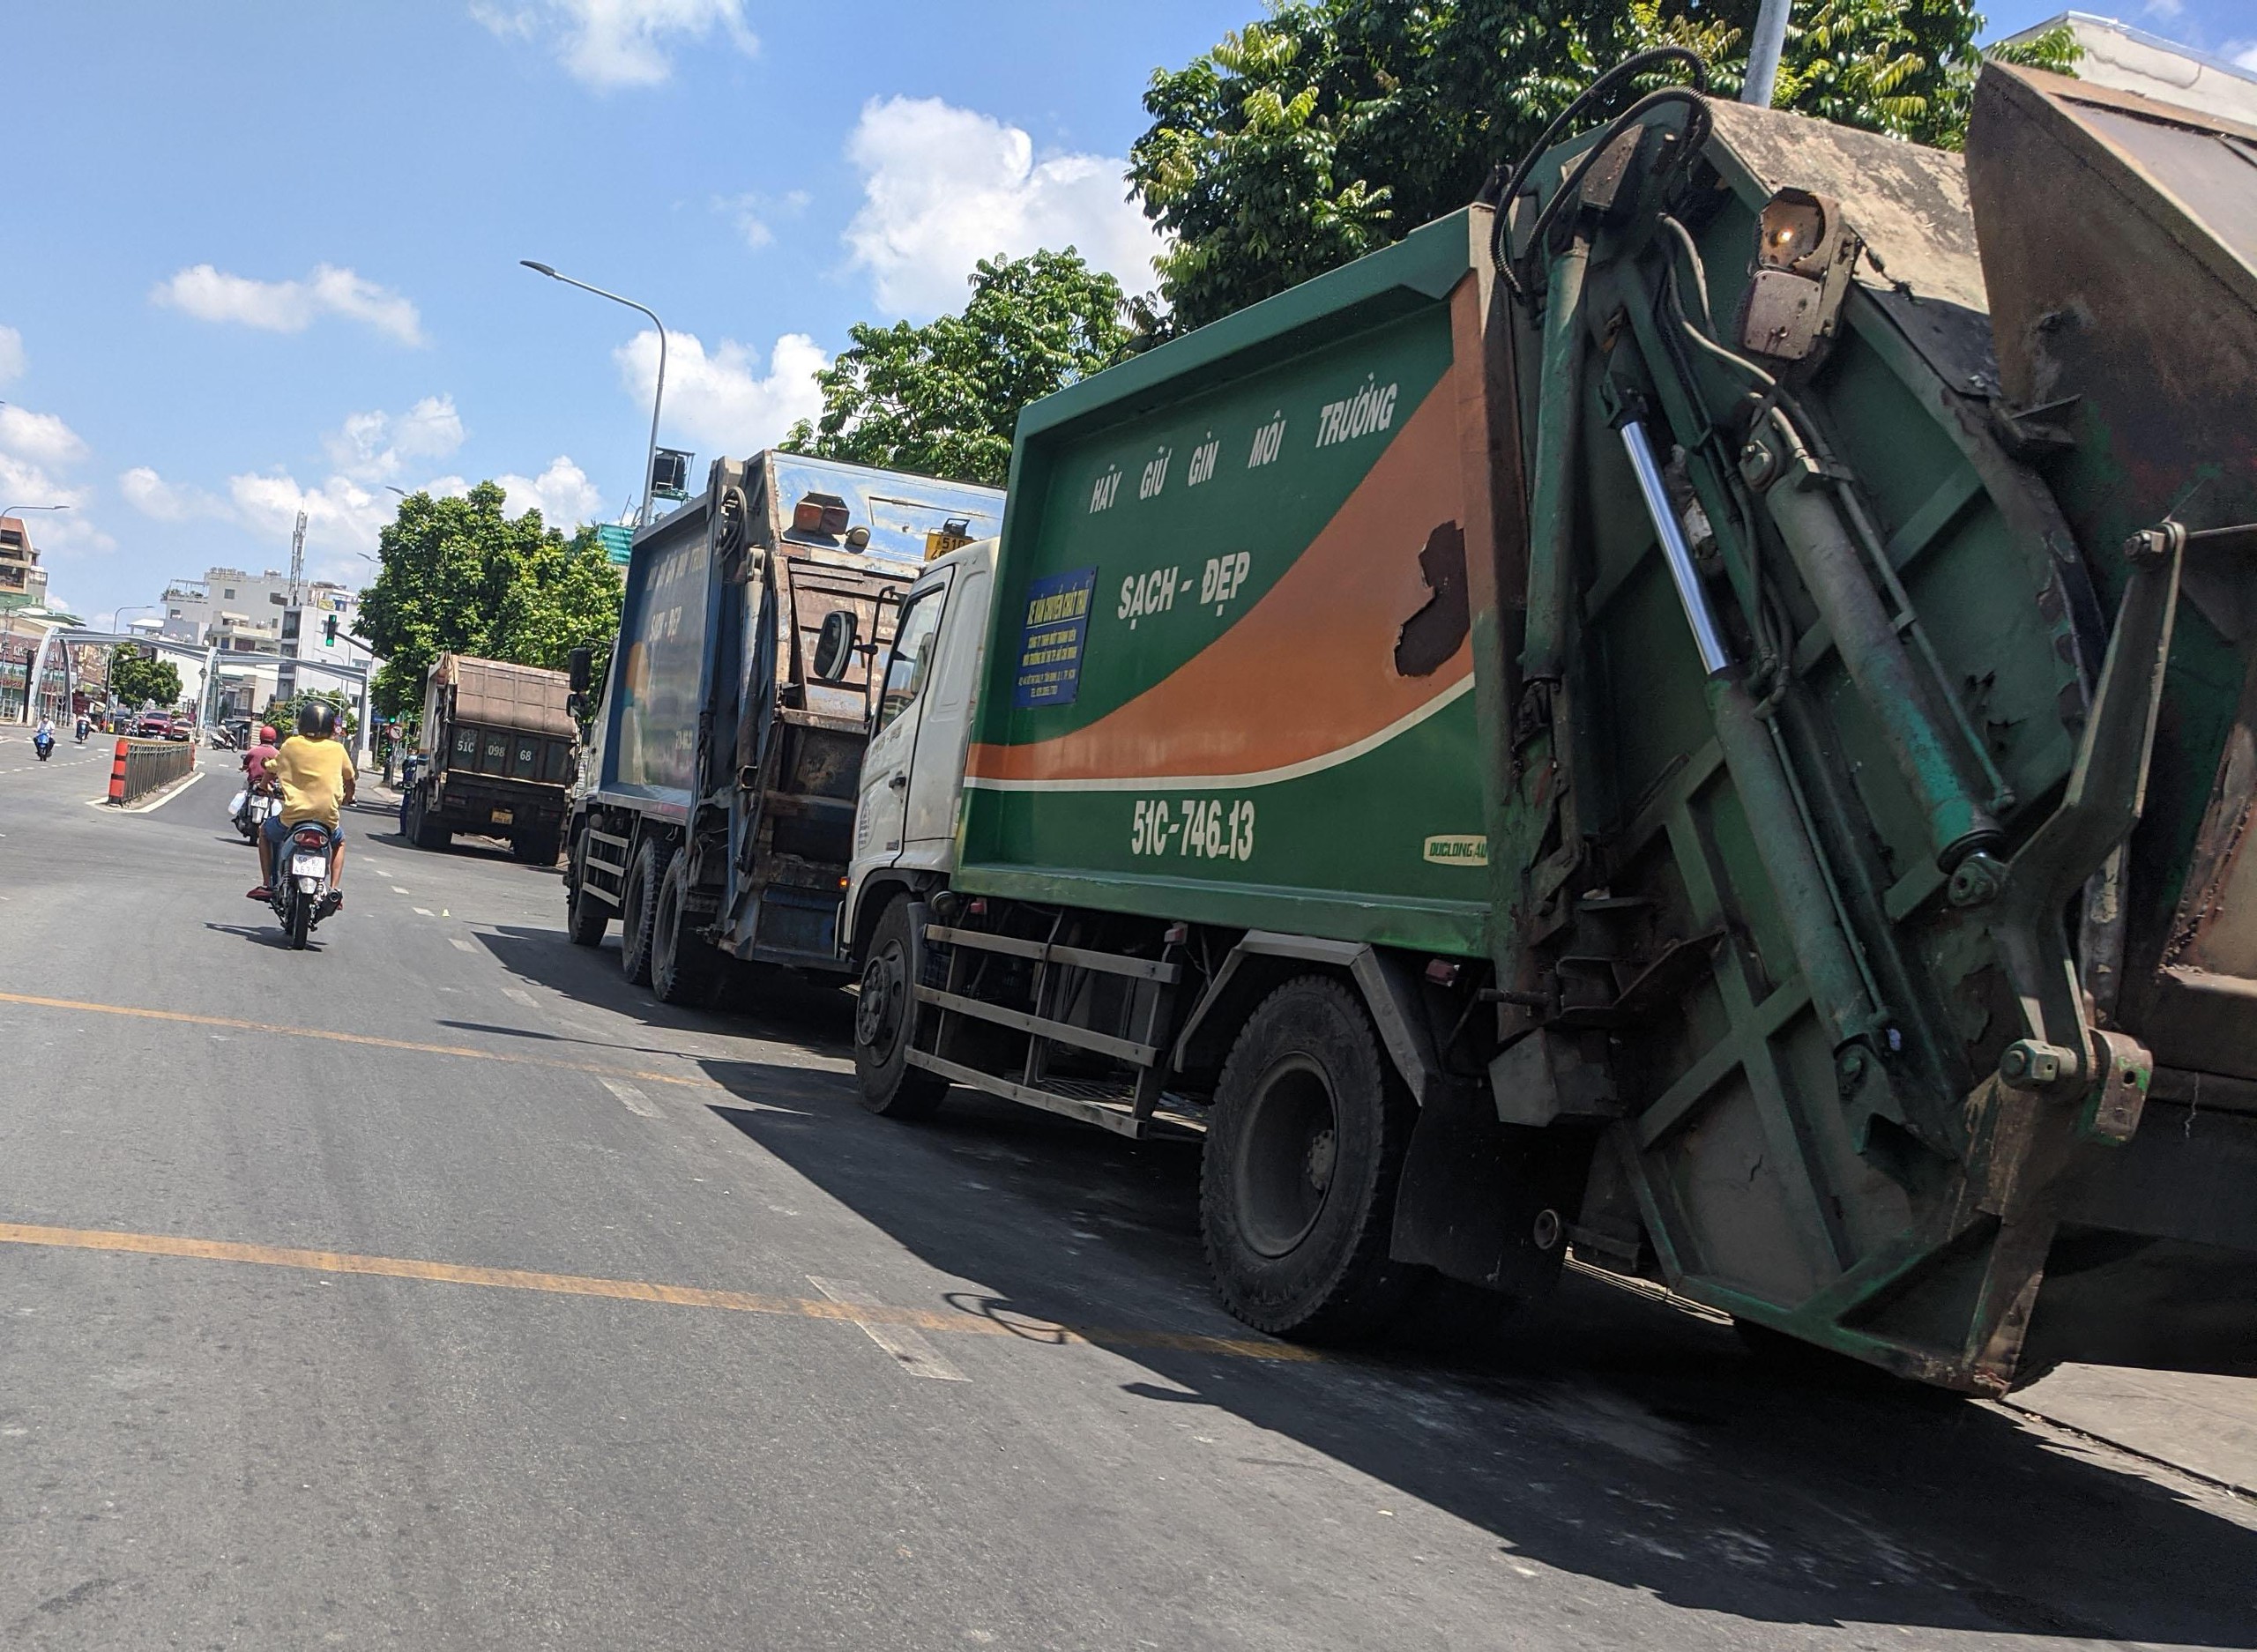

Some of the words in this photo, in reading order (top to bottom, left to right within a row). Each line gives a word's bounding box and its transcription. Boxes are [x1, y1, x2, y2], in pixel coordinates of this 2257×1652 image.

[1248, 409, 1287, 469] MÔI
[457, 740, 475, 753] 51C
[488, 745, 506, 757] 098
[519, 749, 532, 762] 68
